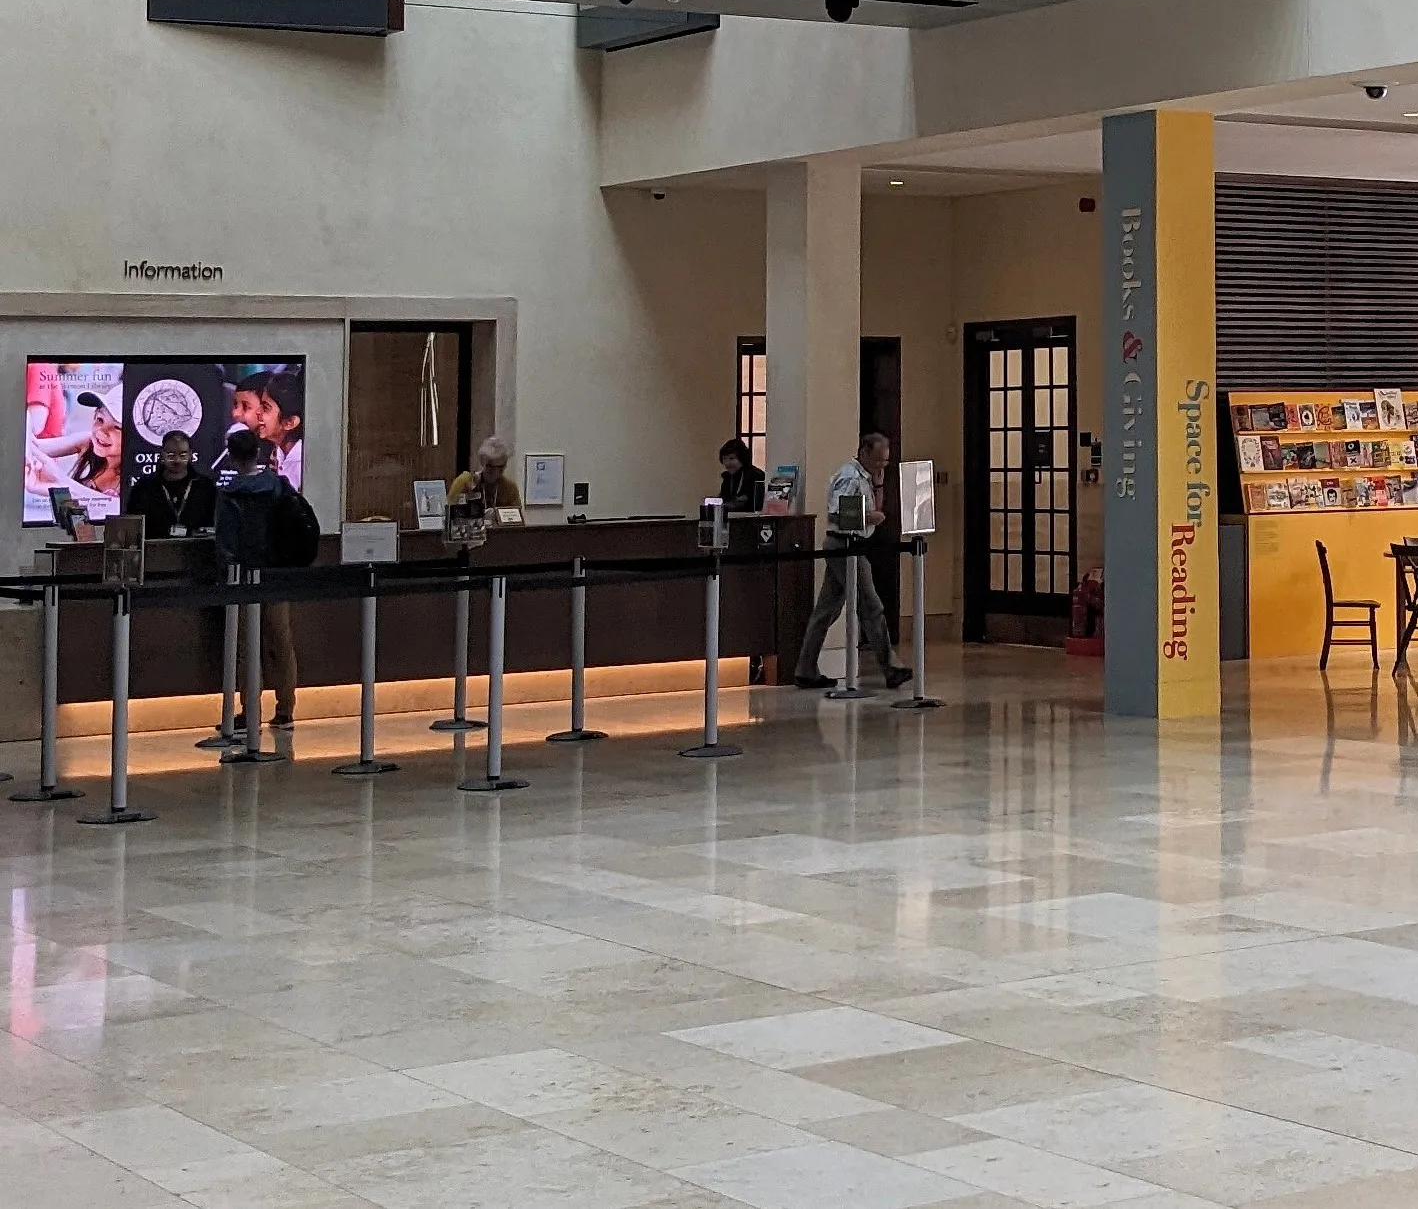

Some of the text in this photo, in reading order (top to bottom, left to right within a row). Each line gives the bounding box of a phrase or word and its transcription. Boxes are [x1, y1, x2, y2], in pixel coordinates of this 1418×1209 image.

[124, 259, 224, 281] Information
[39, 369, 112, 382] Summer fun
[1115, 207, 1143, 500] Books & Giving
[1178, 379, 1211, 527] Space for
[1163, 523, 1197, 661] Reading
